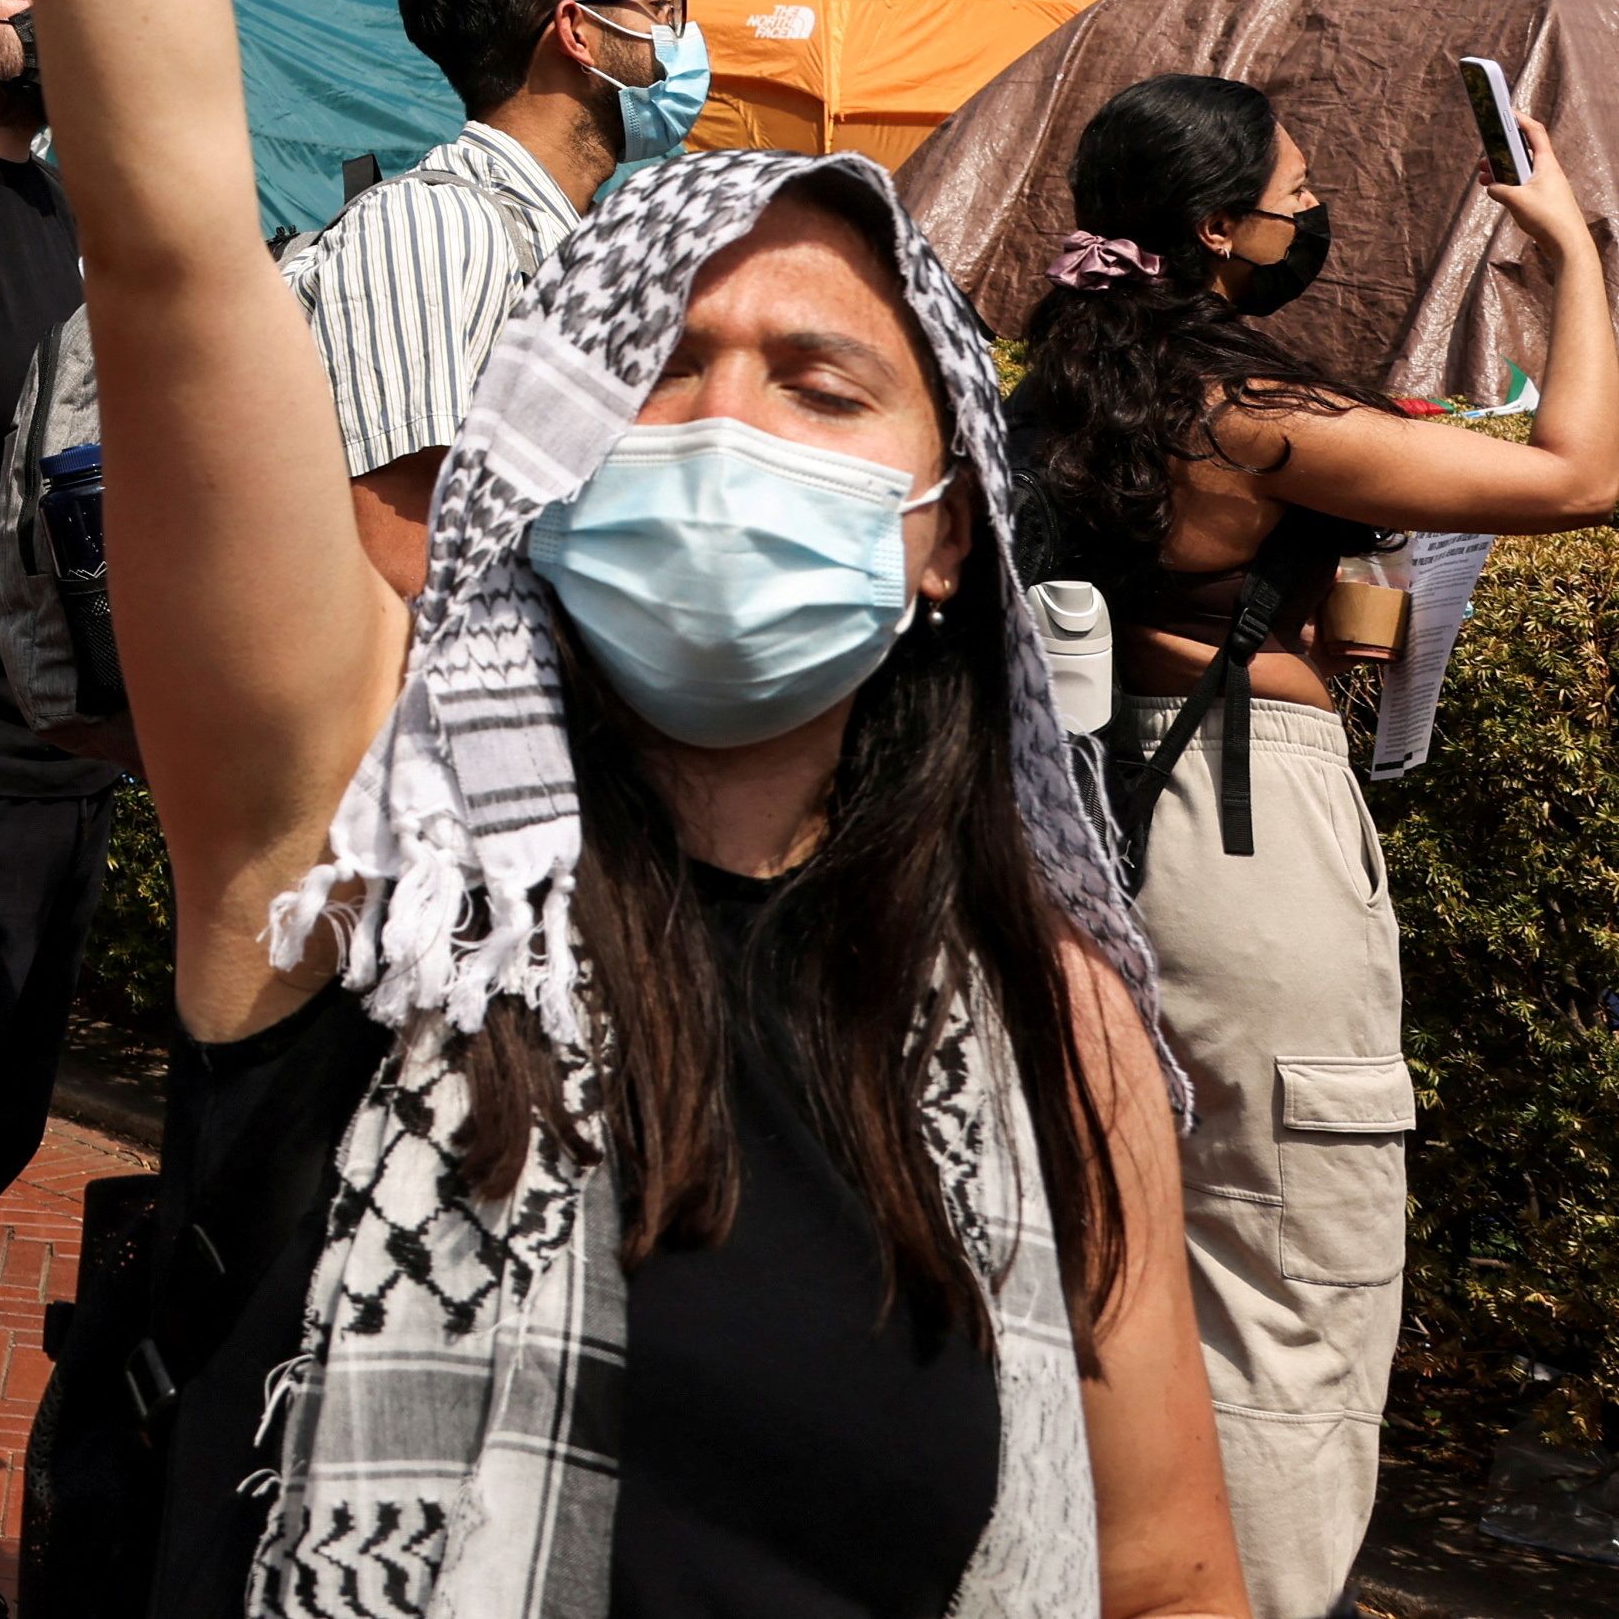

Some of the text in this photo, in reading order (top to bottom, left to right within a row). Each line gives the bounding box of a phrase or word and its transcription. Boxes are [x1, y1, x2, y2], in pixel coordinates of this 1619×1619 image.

[774, 4, 799, 16] THE
[746, 14, 794, 28] NORTH
[754, 26, 792, 39] FACE
